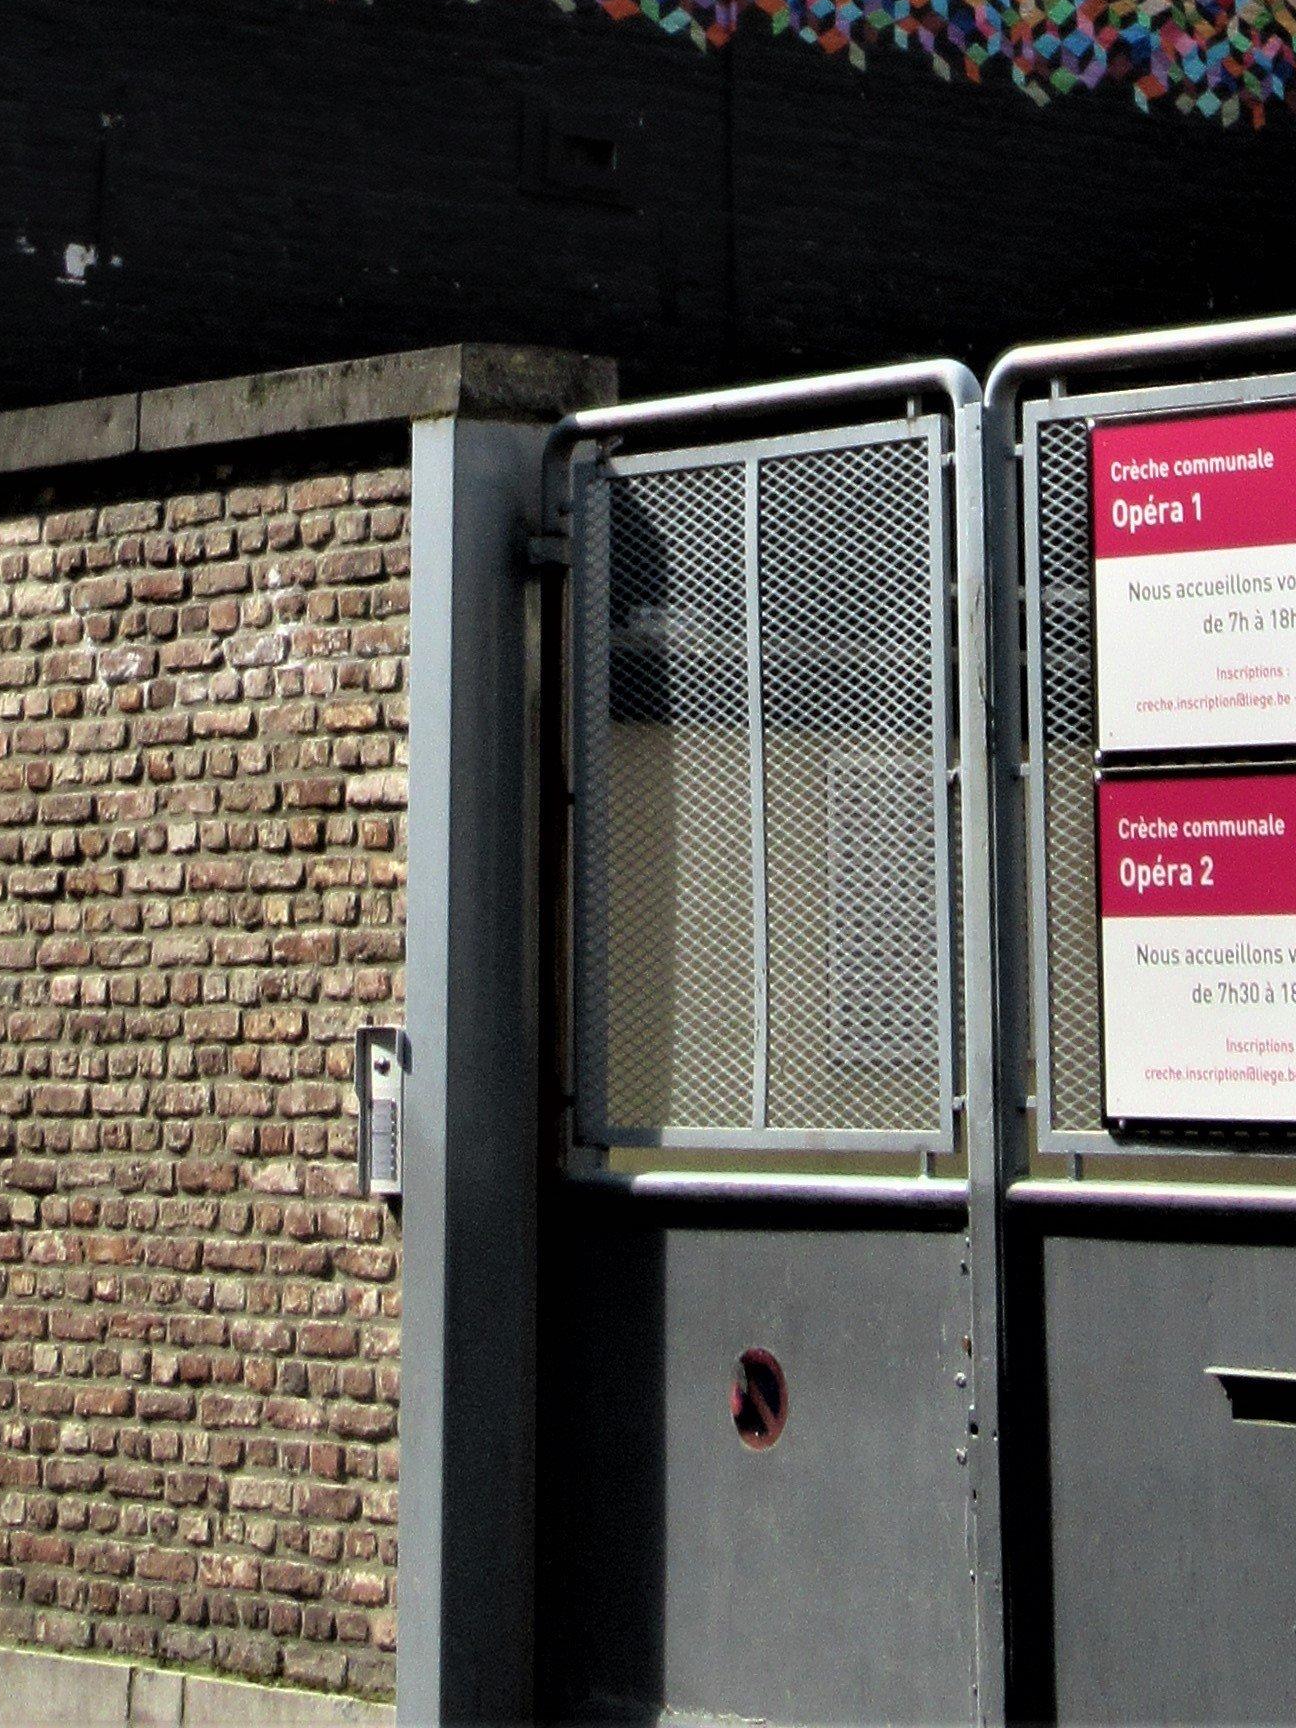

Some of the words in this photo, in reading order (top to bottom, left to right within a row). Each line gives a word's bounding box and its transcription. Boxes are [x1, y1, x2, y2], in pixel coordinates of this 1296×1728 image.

[1110, 458, 1168, 482] Crèche
[1173, 448, 1274, 476] communale
[1112, 495, 1184, 534] Opéra
[1191, 493, 1202, 521] 1
[1128, 581, 1171, 602] Nous
[1176, 574, 1272, 598] accueillons
[1203, 614, 1223, 634] de
[1229, 611, 1249, 632] 7h
[1254, 610, 1264, 631] à
[1216, 665, 1283, 682] Inscriptions
[1118, 815, 1178, 839] Crèche
[1183, 813, 1285, 837] communale
[1120, 854, 1193, 894] Opéra
[1200, 855, 1214, 886] 2
[1136, 944, 1180, 966] Nous
[1185, 943, 1284, 964] accueillons
[1192, 984, 1213, 1003] de
[1218, 982, 1260, 1003] 7h30
[1265, 982, 1275, 1003] à
[1226, 1037, 1295, 1055] Inscriptions
